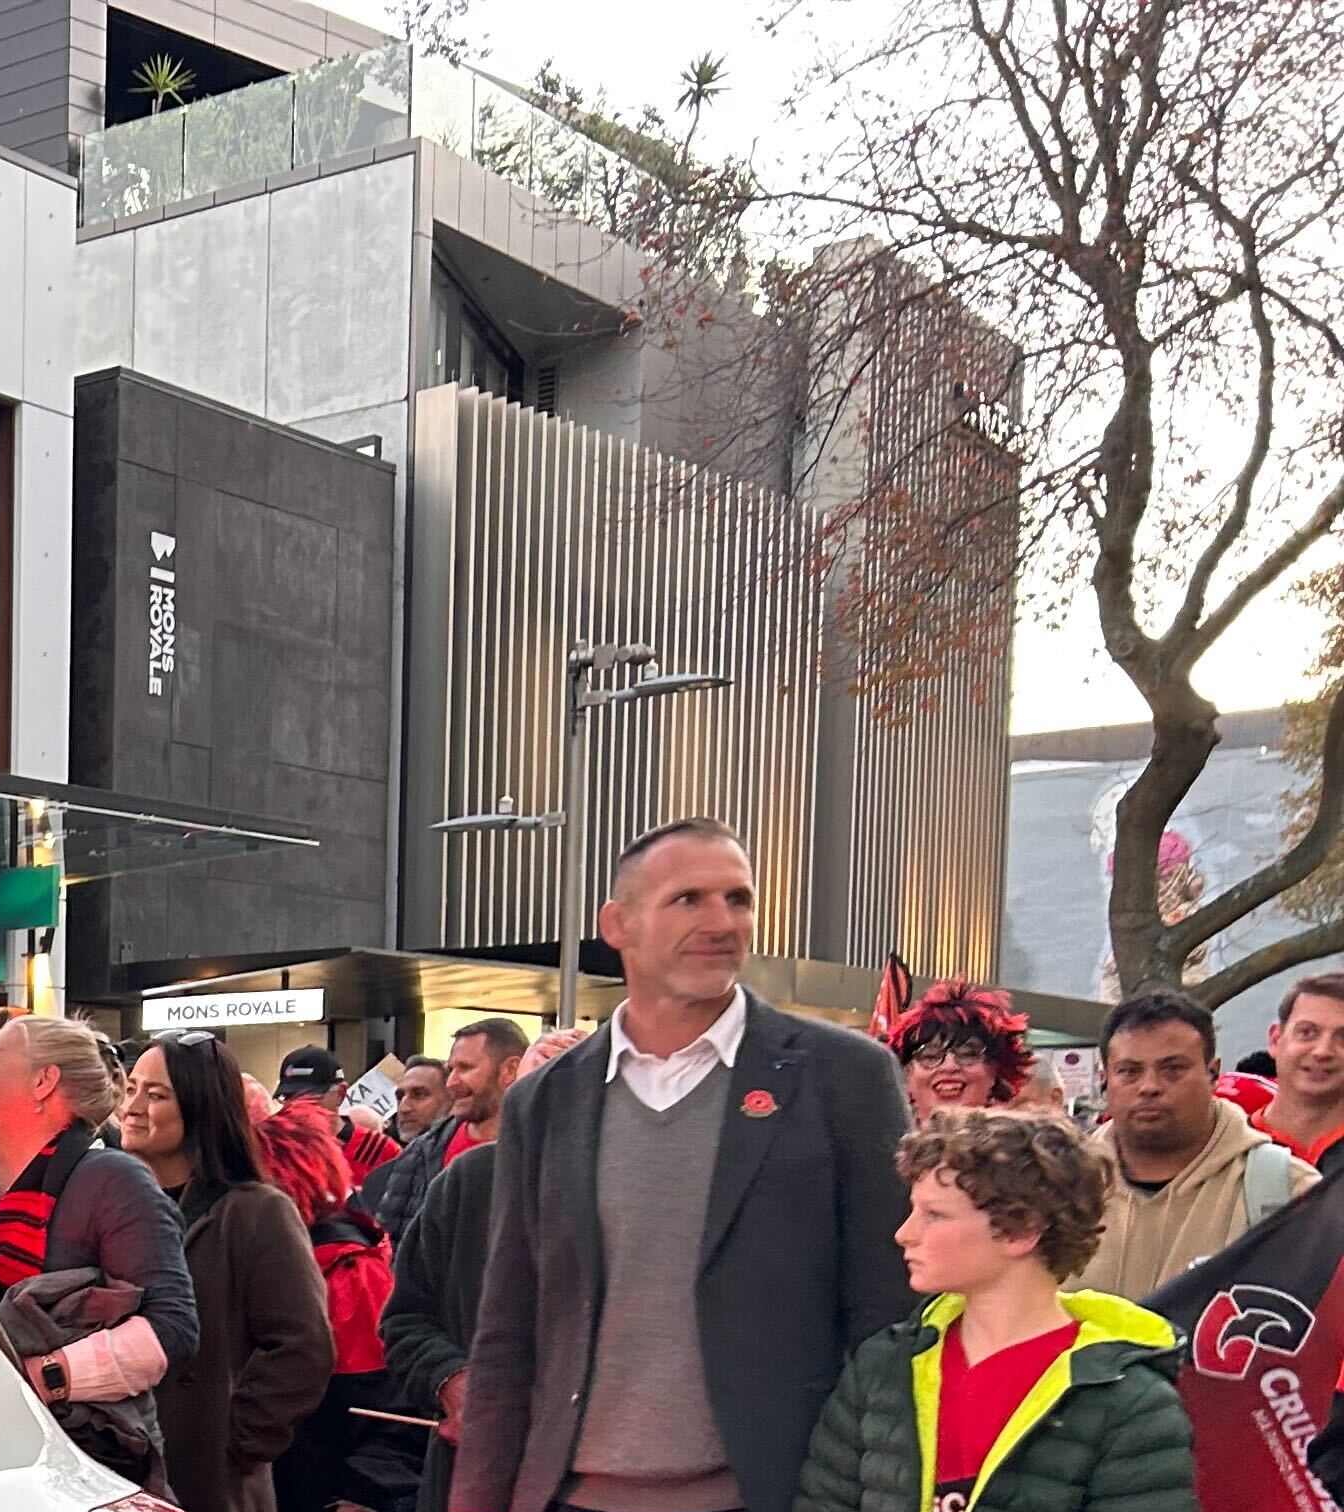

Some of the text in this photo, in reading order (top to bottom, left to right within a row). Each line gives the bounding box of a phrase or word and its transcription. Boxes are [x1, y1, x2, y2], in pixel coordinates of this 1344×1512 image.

[149, 584, 163, 696] ROYALE
[162, 587, 175, 672] MONS
[167, 999, 297, 1022] MONS ROYALE
